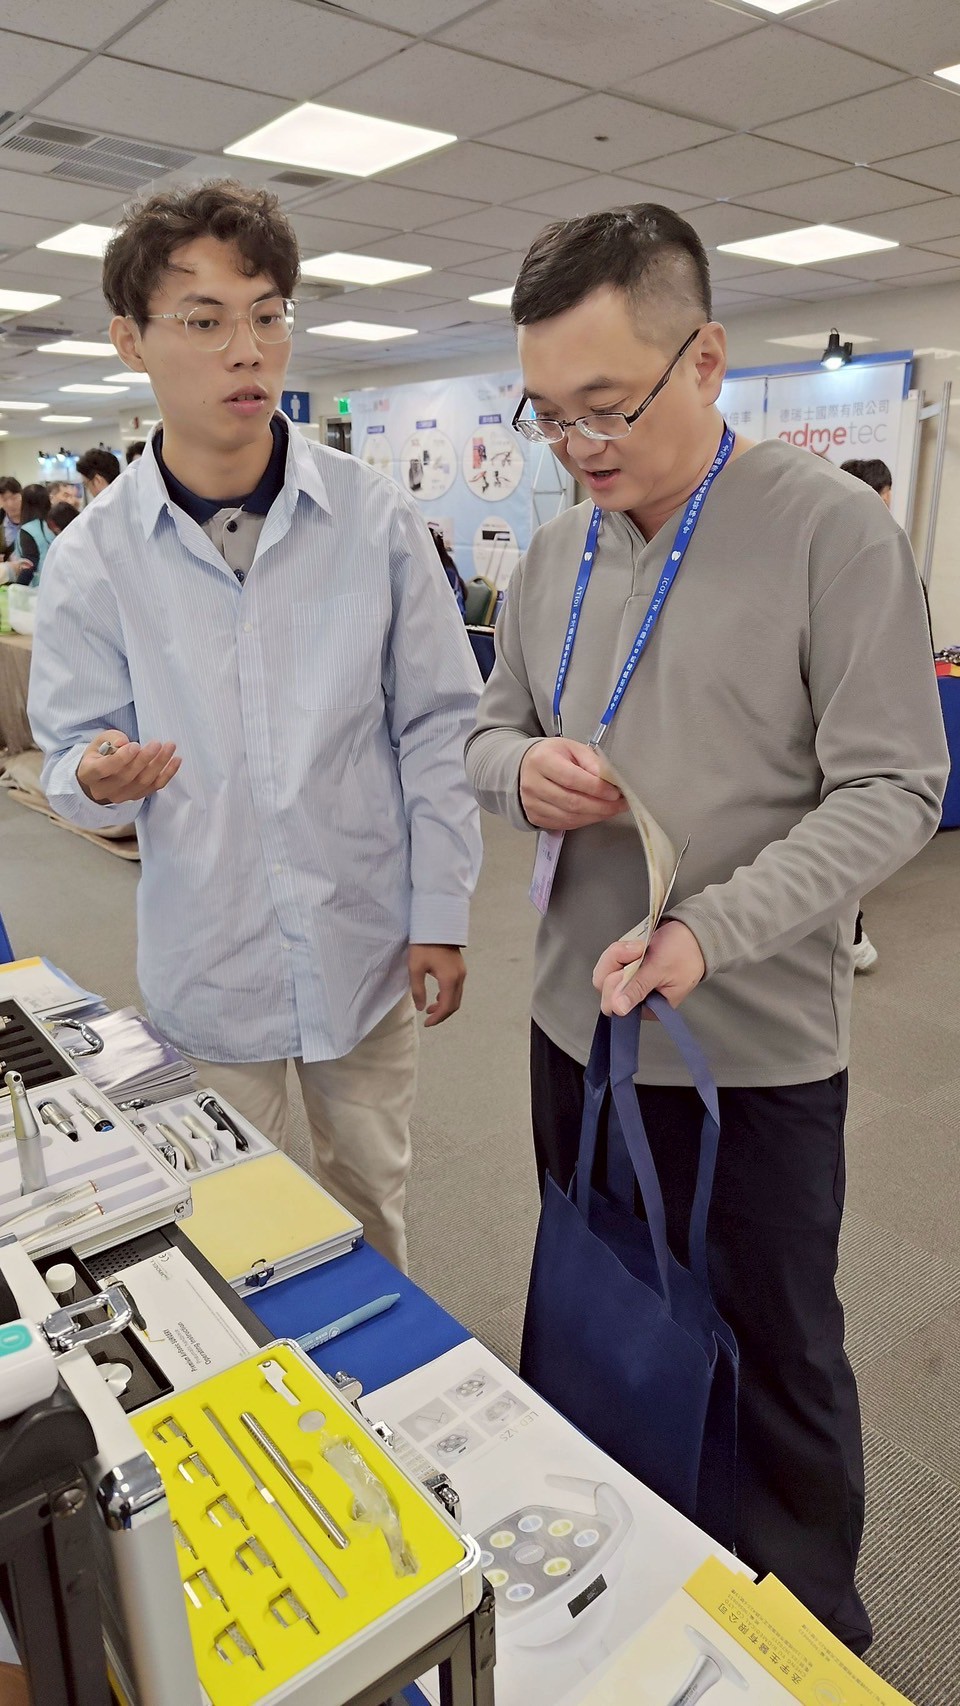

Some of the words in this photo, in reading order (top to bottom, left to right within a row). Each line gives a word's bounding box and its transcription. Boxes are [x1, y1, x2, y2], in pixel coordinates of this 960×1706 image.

[780, 400, 889, 423] 德瑞士國際有限公司
[659, 576, 670, 596] ICOI
[650, 597, 661, 611] TW
[176, 1320, 196, 1344] Instruction
[183, 1355, 198, 1372] Premium
[192, 1341, 211, 1365] Operating
